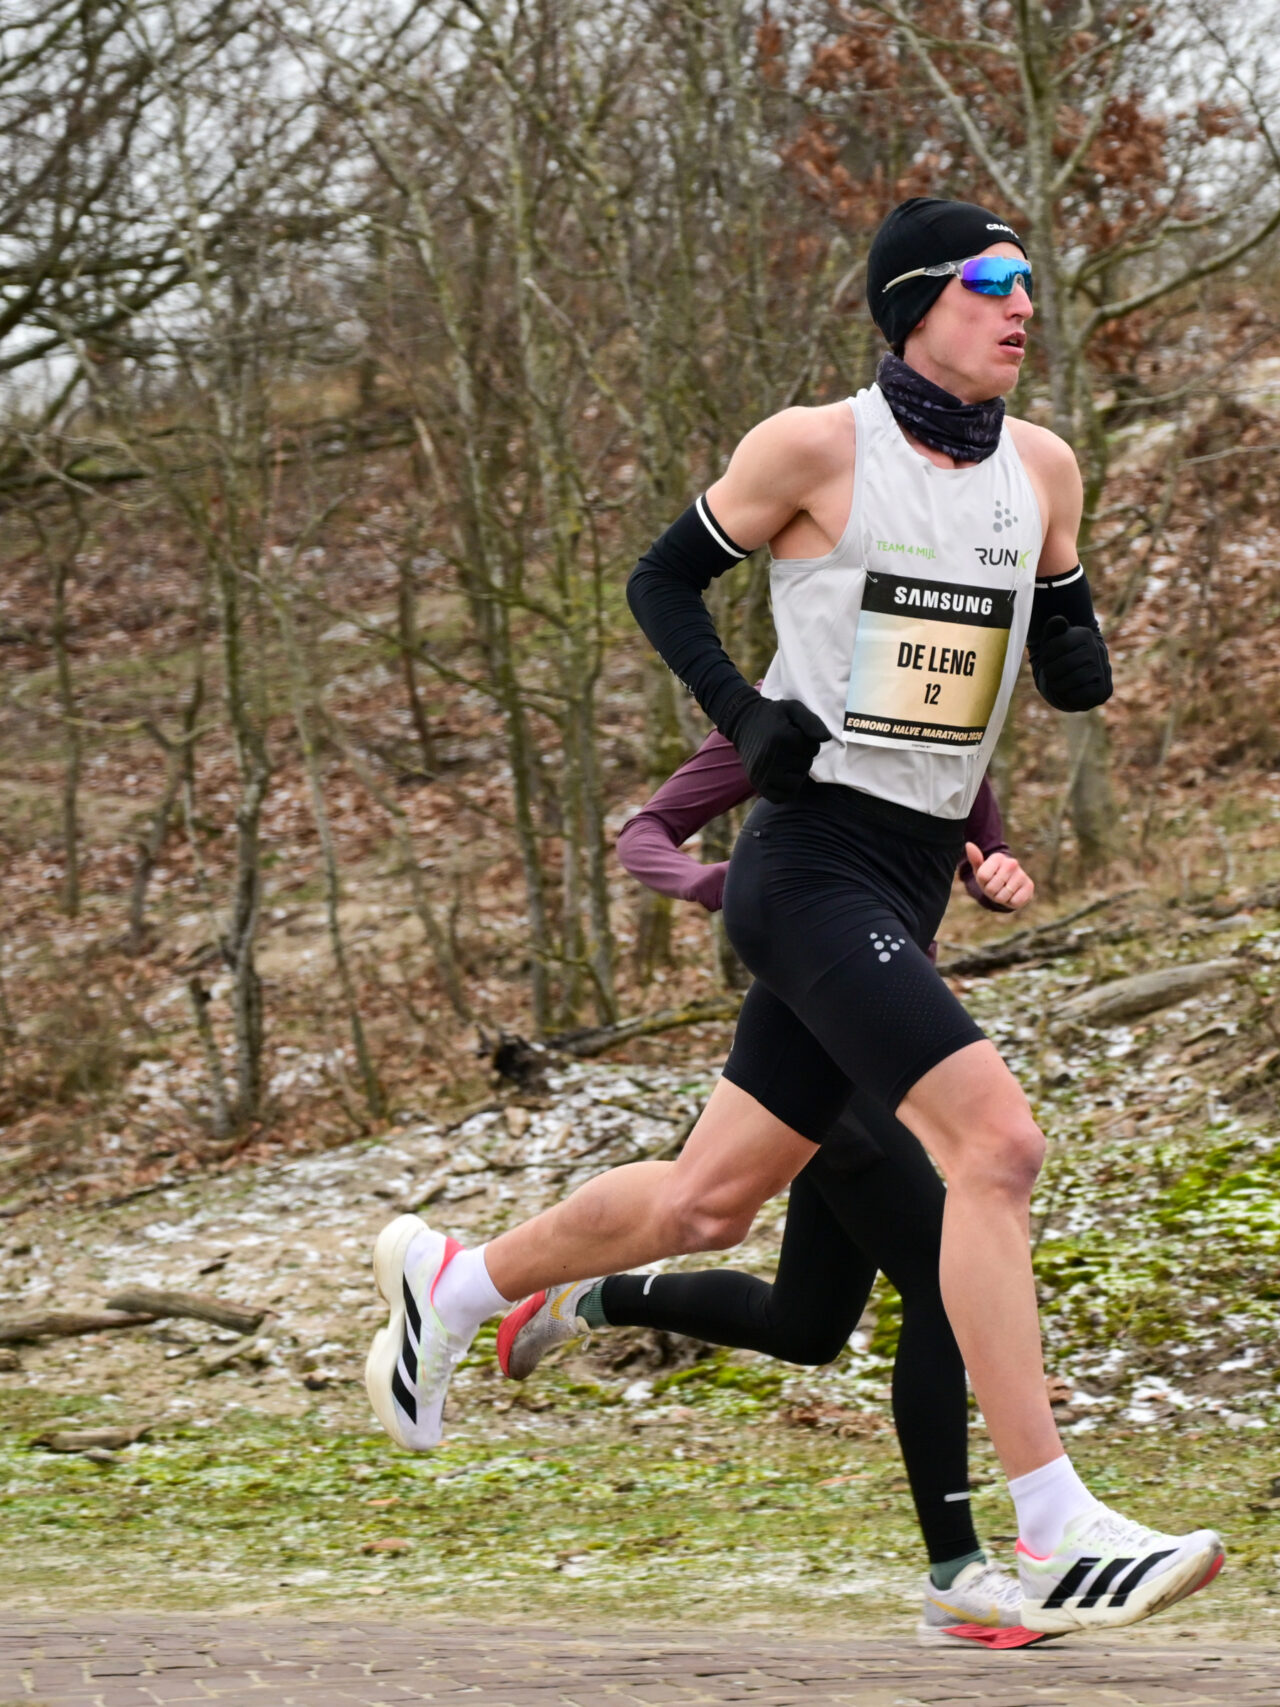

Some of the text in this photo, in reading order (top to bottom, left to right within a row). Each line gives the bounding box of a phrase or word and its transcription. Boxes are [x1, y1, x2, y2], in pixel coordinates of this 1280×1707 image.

[876, 540, 937, 560] TEAM 4 MIJL
[894, 586, 993, 616] SAMSUNG
[897, 641, 977, 677] DE LENG
[923, 682, 942, 706] 12
[846, 717, 891, 732] EGMOND
[892, 724, 922, 736] HALVE
[922, 728, 968, 741] MARATHON
